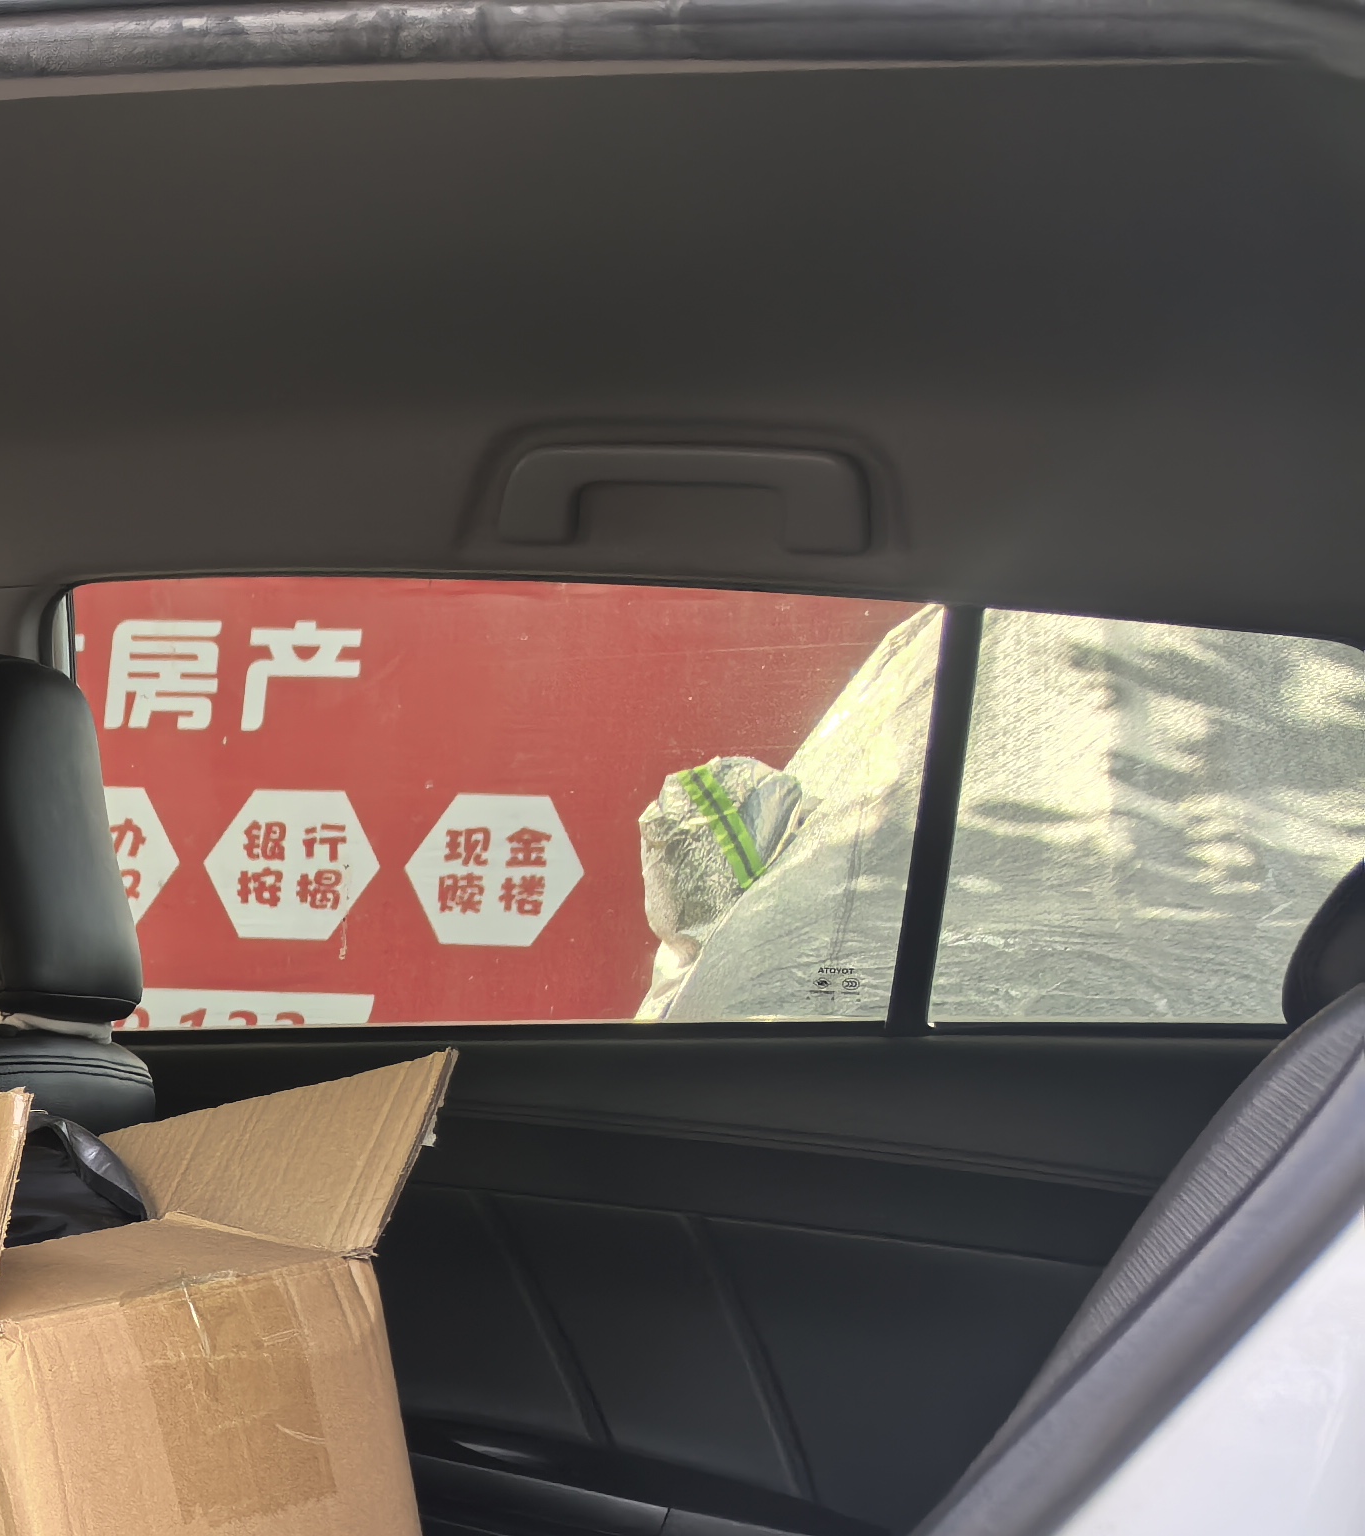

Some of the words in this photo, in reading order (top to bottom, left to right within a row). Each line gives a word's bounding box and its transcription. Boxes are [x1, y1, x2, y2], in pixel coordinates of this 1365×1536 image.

[75, 619, 363, 731] 房产
[243, 820, 347, 862] 银行
[444, 826, 552, 868] 现金
[237, 867, 342, 910] 按揭
[438, 872, 545, 916] 赎楼
